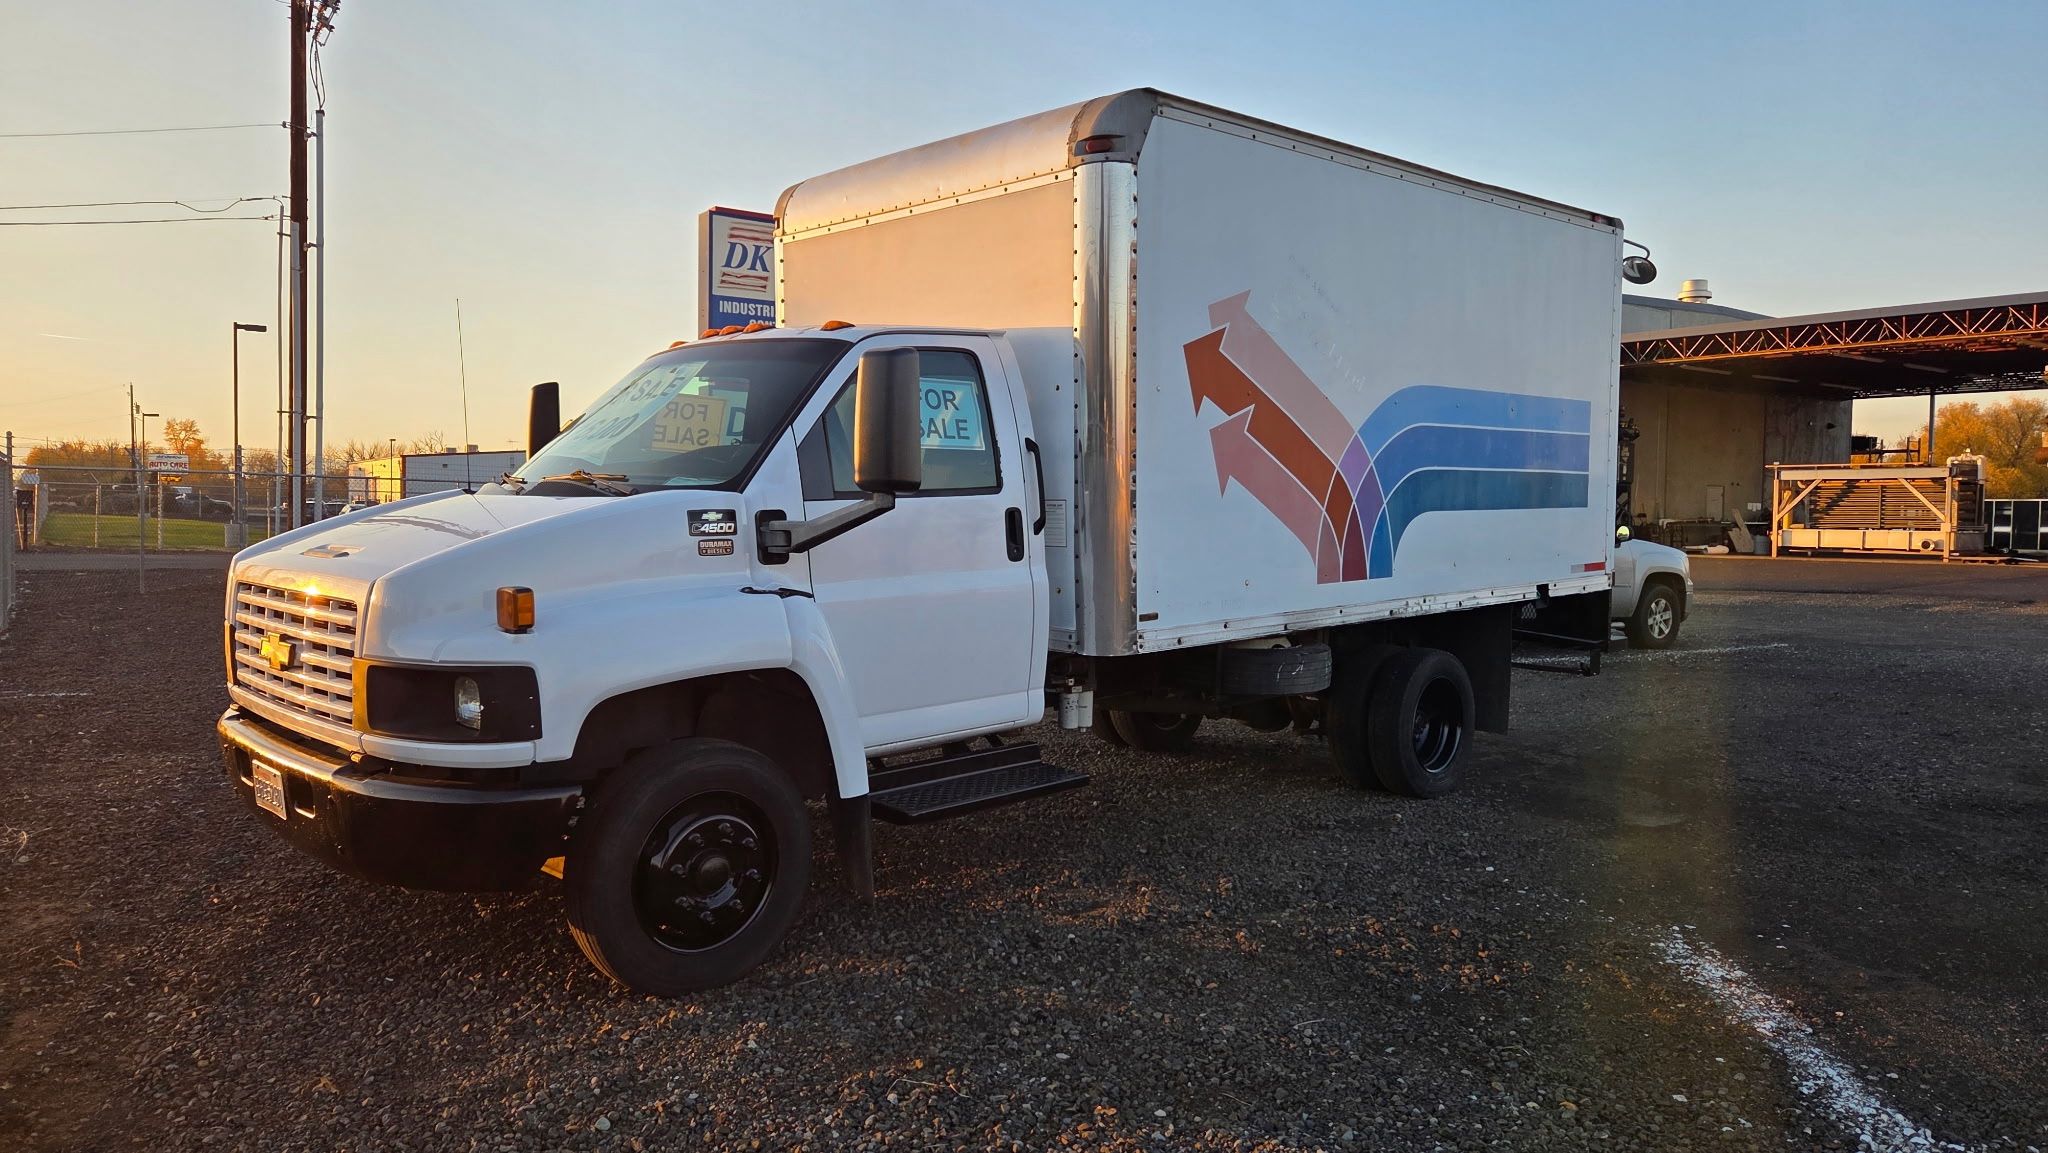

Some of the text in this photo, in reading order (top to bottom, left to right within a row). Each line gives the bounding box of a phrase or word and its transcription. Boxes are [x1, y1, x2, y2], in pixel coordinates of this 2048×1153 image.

[721, 241, 774, 272] DK
[719, 300, 774, 317] INDUSTRI
[919, 388, 959, 411] OR
[169, 461, 188, 469] CARE
[692, 523, 735, 533] C4500
